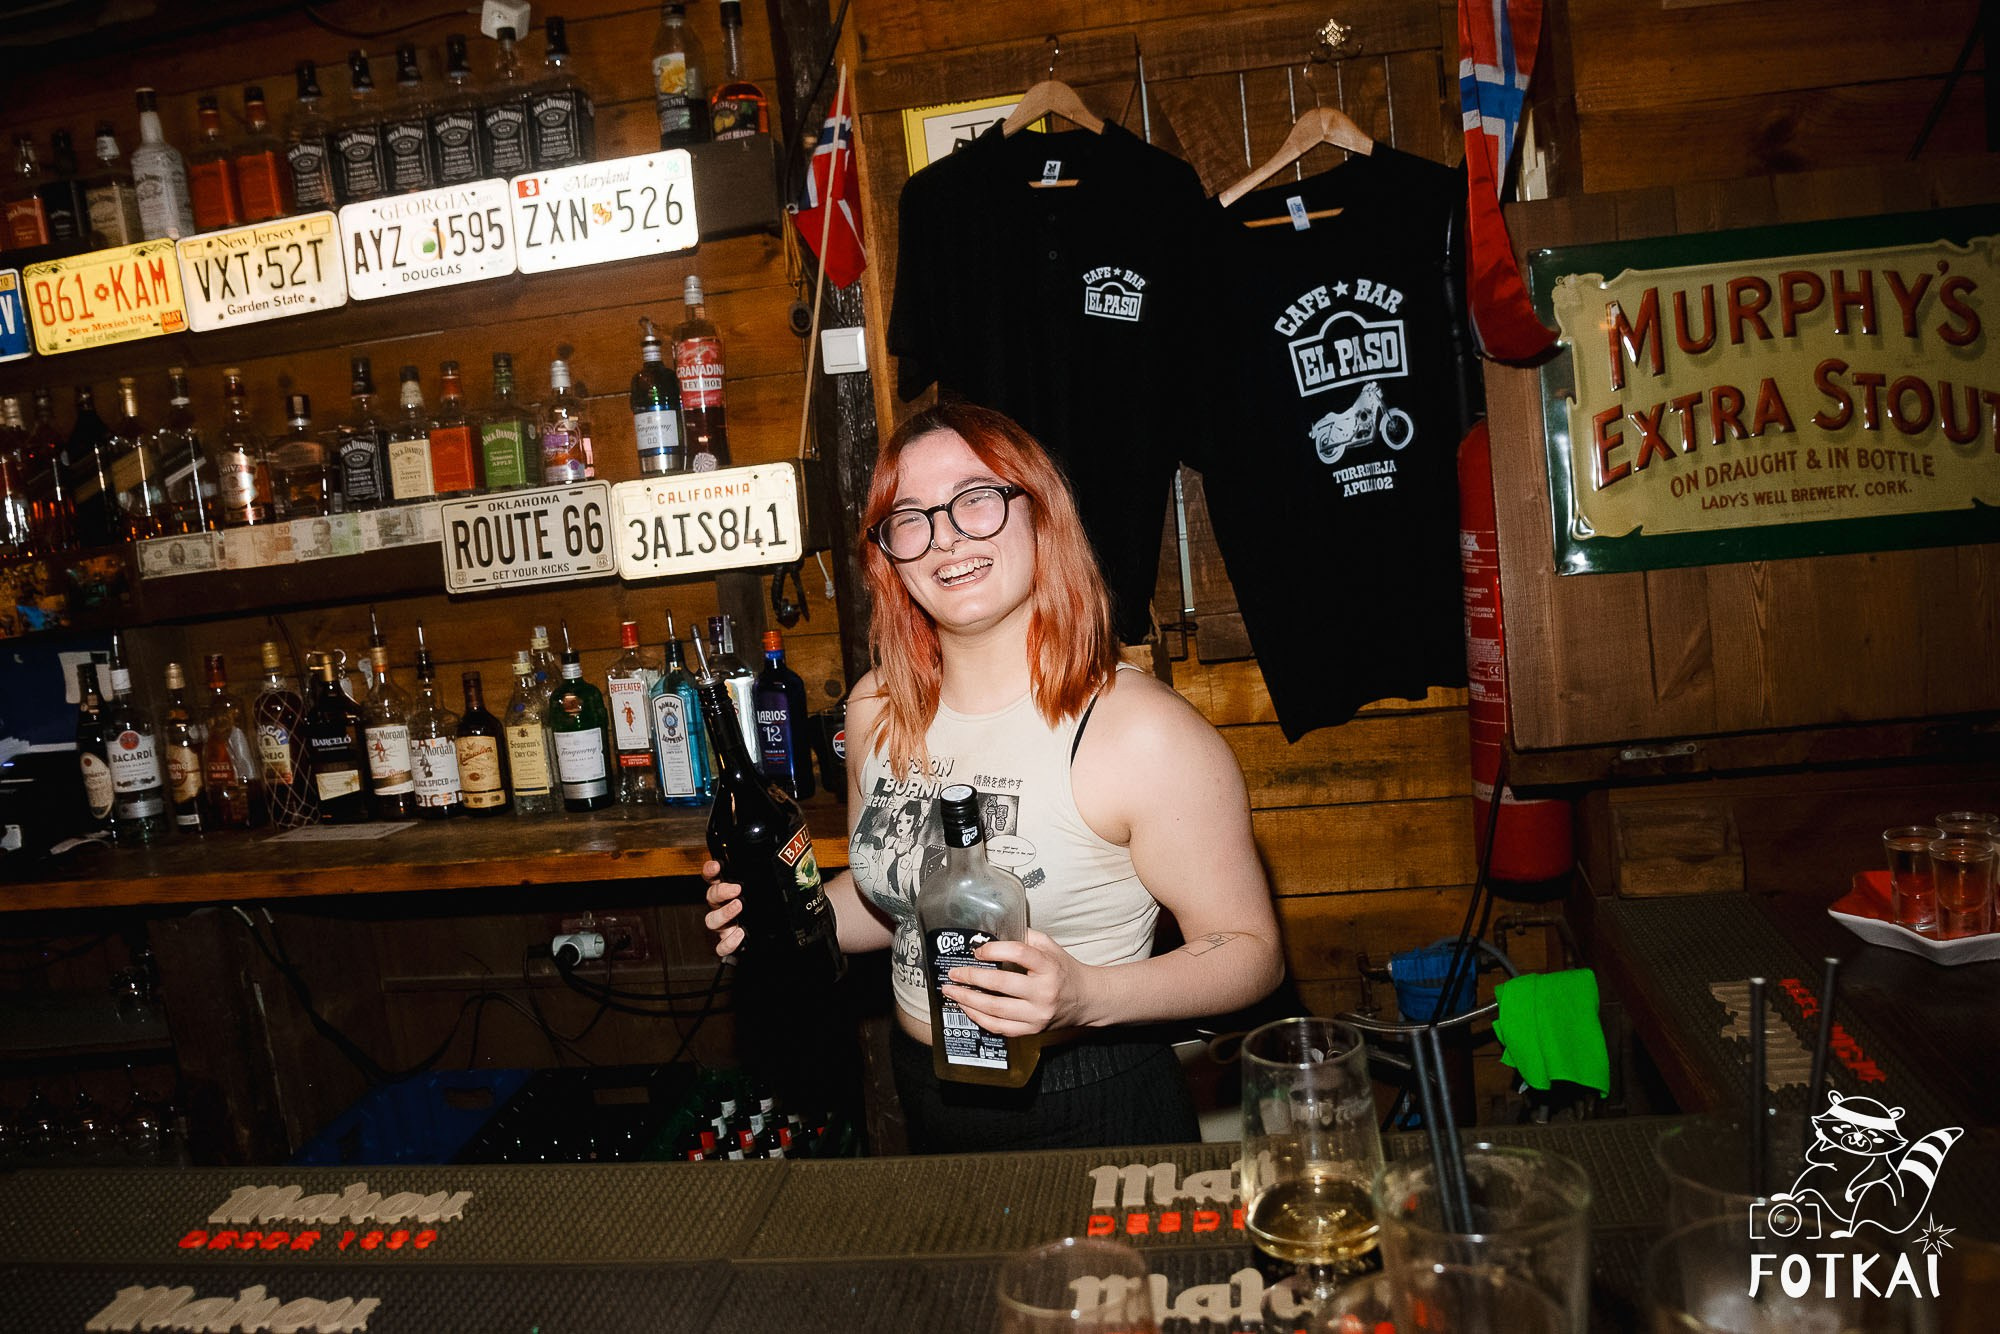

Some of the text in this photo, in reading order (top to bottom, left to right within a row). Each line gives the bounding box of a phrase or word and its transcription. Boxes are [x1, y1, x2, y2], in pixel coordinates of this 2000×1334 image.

[525, 179, 537, 196] 3
[564, 166, 630, 192] Maryland
[380, 192, 470, 221] GEORGIA
[522, 184, 683, 248] ZXN 526
[216, 226, 296, 250] New Jersey
[354, 207, 505, 274] AYZ 1595
[194, 238, 323, 302] VXT 52T
[402, 264, 463, 282] DOUGLAS
[1083, 266, 1146, 291] CAFE BAR
[34, 257, 170, 326] 861 KAM
[227, 293, 306, 316] Garden State
[1088, 292, 1140, 317] EL PASO
[1274, 279, 1403, 337] CAFE BAR
[68, 313, 154, 337] New Mexico USA
[1605, 260, 1982, 392] MURPHY'S
[1299, 331, 1400, 386] EL PASO
[1593, 377, 1797, 491] EXTRA
[1671, 447, 1935, 499] ON DRAUGHT & IN BOTTLE
[487, 494, 561, 512] OKLAHOMA
[657, 483, 751, 505] CALIFORNIA
[1701, 491, 1749, 511] LADY'S
[1752, 489, 1788, 507] WELL
[278, 525, 290, 535] 50
[452, 502, 604, 570] ROUTE 66
[628, 503, 788, 562] 3AIS841
[492, 562, 570, 580] GET YOUR KICKS
[610, 682, 641, 694] BEEFEATER
[658, 701, 679, 715] BOMBAY
[757, 710, 787, 724] LARIOS
[312, 735, 352, 748] BARCELÓ
[379, 728, 405, 740] Morgan
[510, 739, 541, 750] Seagram's
[661, 732, 684, 744] SAPPHIRE
[763, 725, 783, 742] 12
[112, 747, 153, 764] BACARDÍ
[425, 742, 455, 757] Morgan
[972, 773, 1024, 790] 情熱を燃やす
[936, 934, 965, 954] LOCO
[208, 1181, 474, 1224] Mahou
[84, 1284, 382, 1334] Mahou
